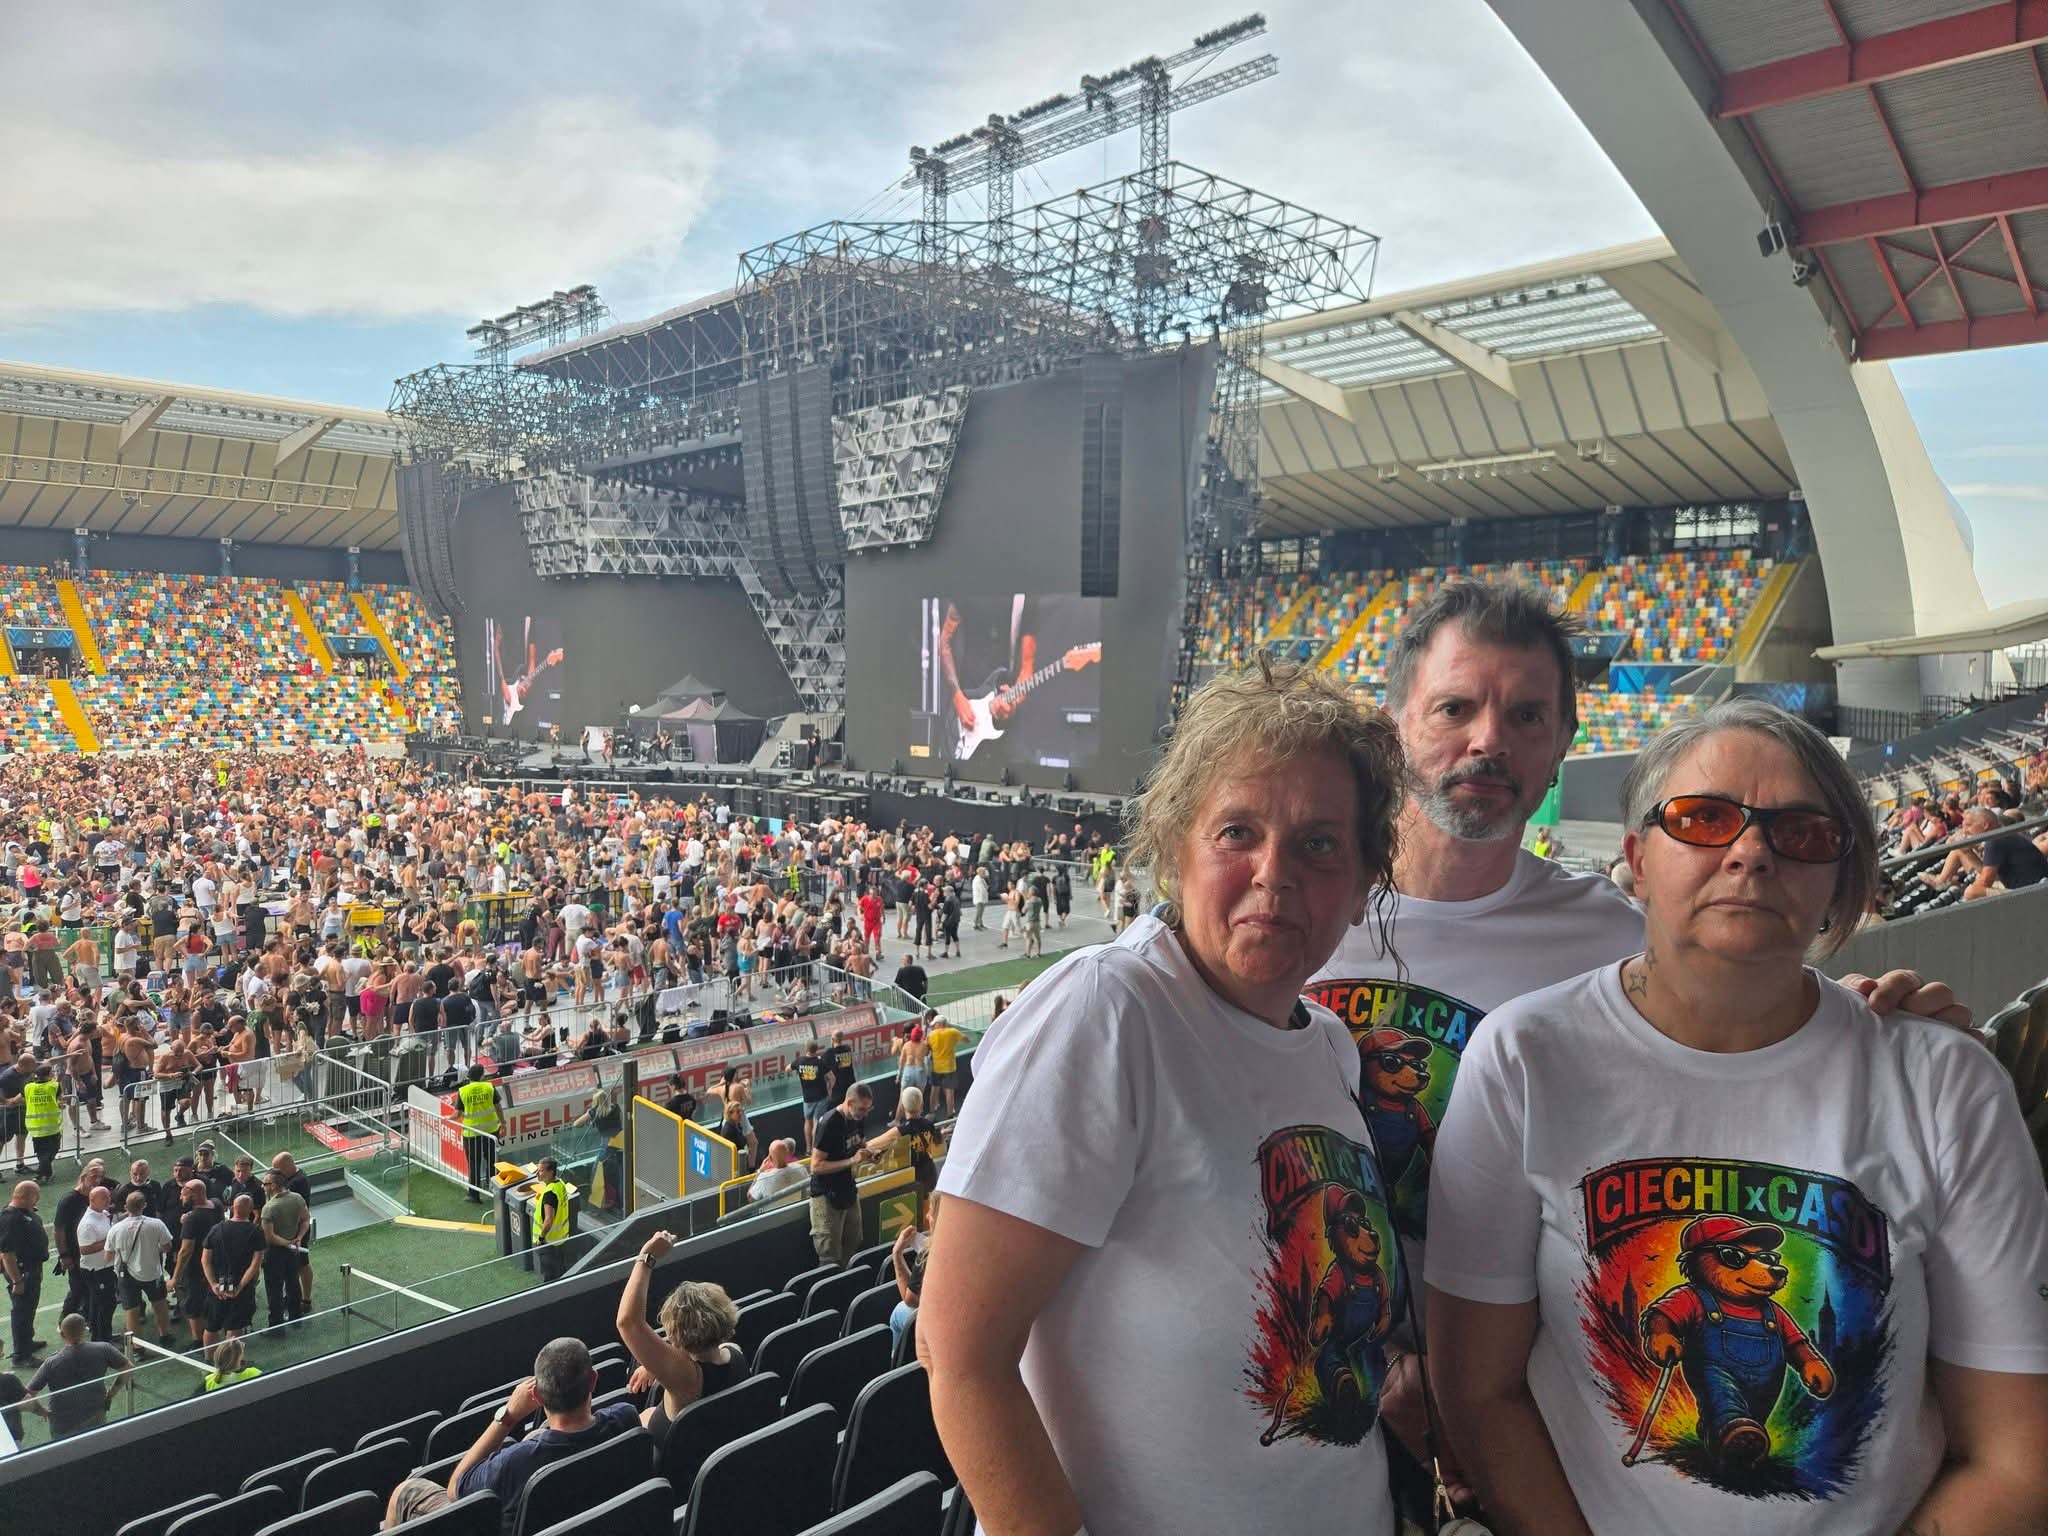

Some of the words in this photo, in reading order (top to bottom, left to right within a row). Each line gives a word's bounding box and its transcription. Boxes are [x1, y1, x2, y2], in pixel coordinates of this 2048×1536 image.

[1306, 986, 1470, 1050] IECHIxCA
[500, 1099, 592, 1138] IELL
[696, 1151, 706, 1175] 12
[1269, 1135, 1378, 1201] CIECHIxCA
